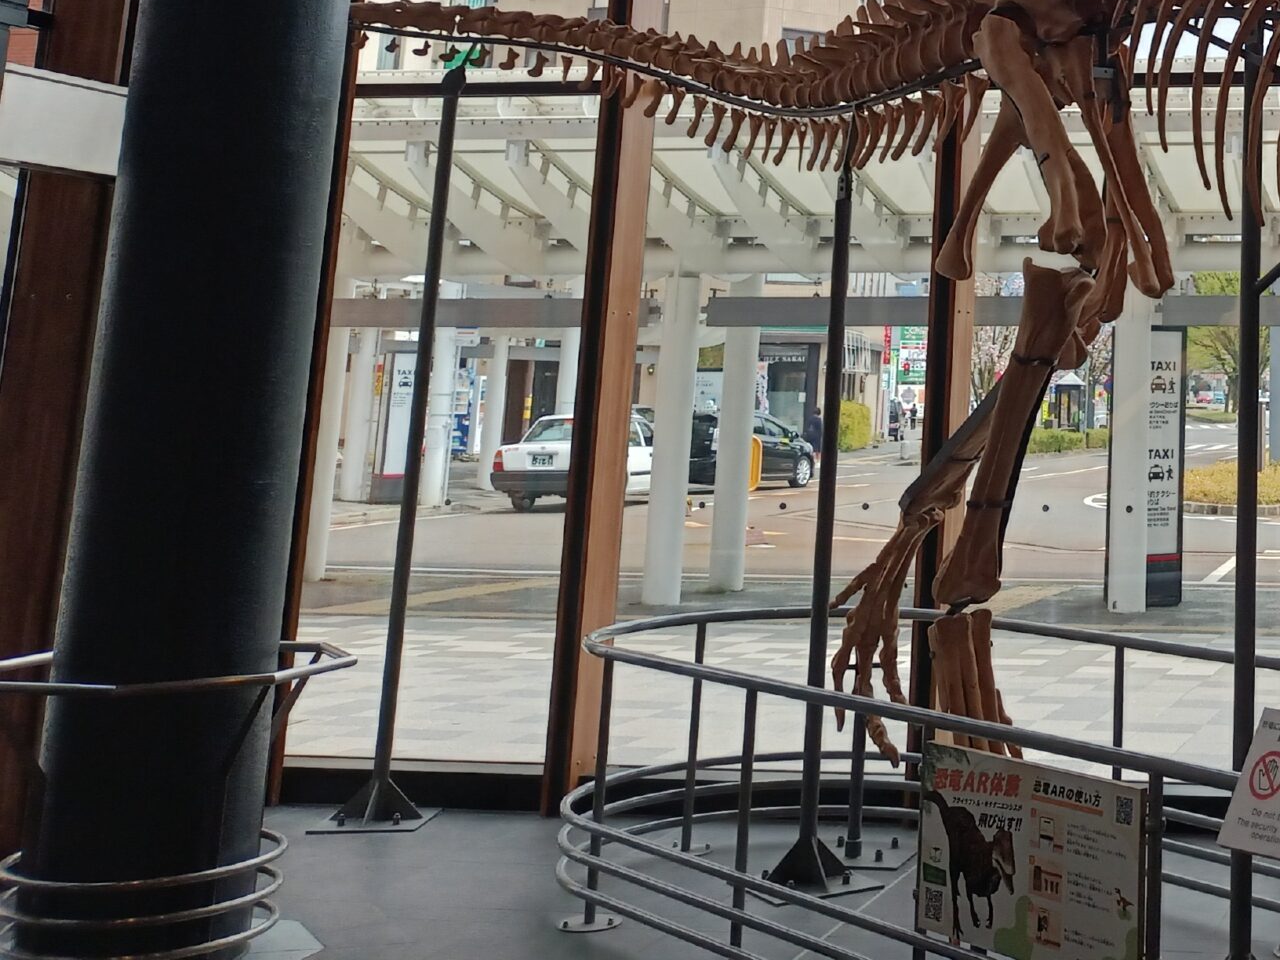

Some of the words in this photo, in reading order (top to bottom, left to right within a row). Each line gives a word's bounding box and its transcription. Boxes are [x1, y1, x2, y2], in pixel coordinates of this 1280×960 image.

[1150, 360, 1177, 371] TAXI
[1148, 448, 1174, 460] TAXI
[933, 767, 1022, 798] 恐竜AR体験
[1033, 779, 1102, 808] 恐竜ARの使い方
[1251, 807, 1262, 817] Do
[1263, 811, 1276, 820] not
[1236, 817, 1250, 828] The
[1250, 821, 1278, 834] security
